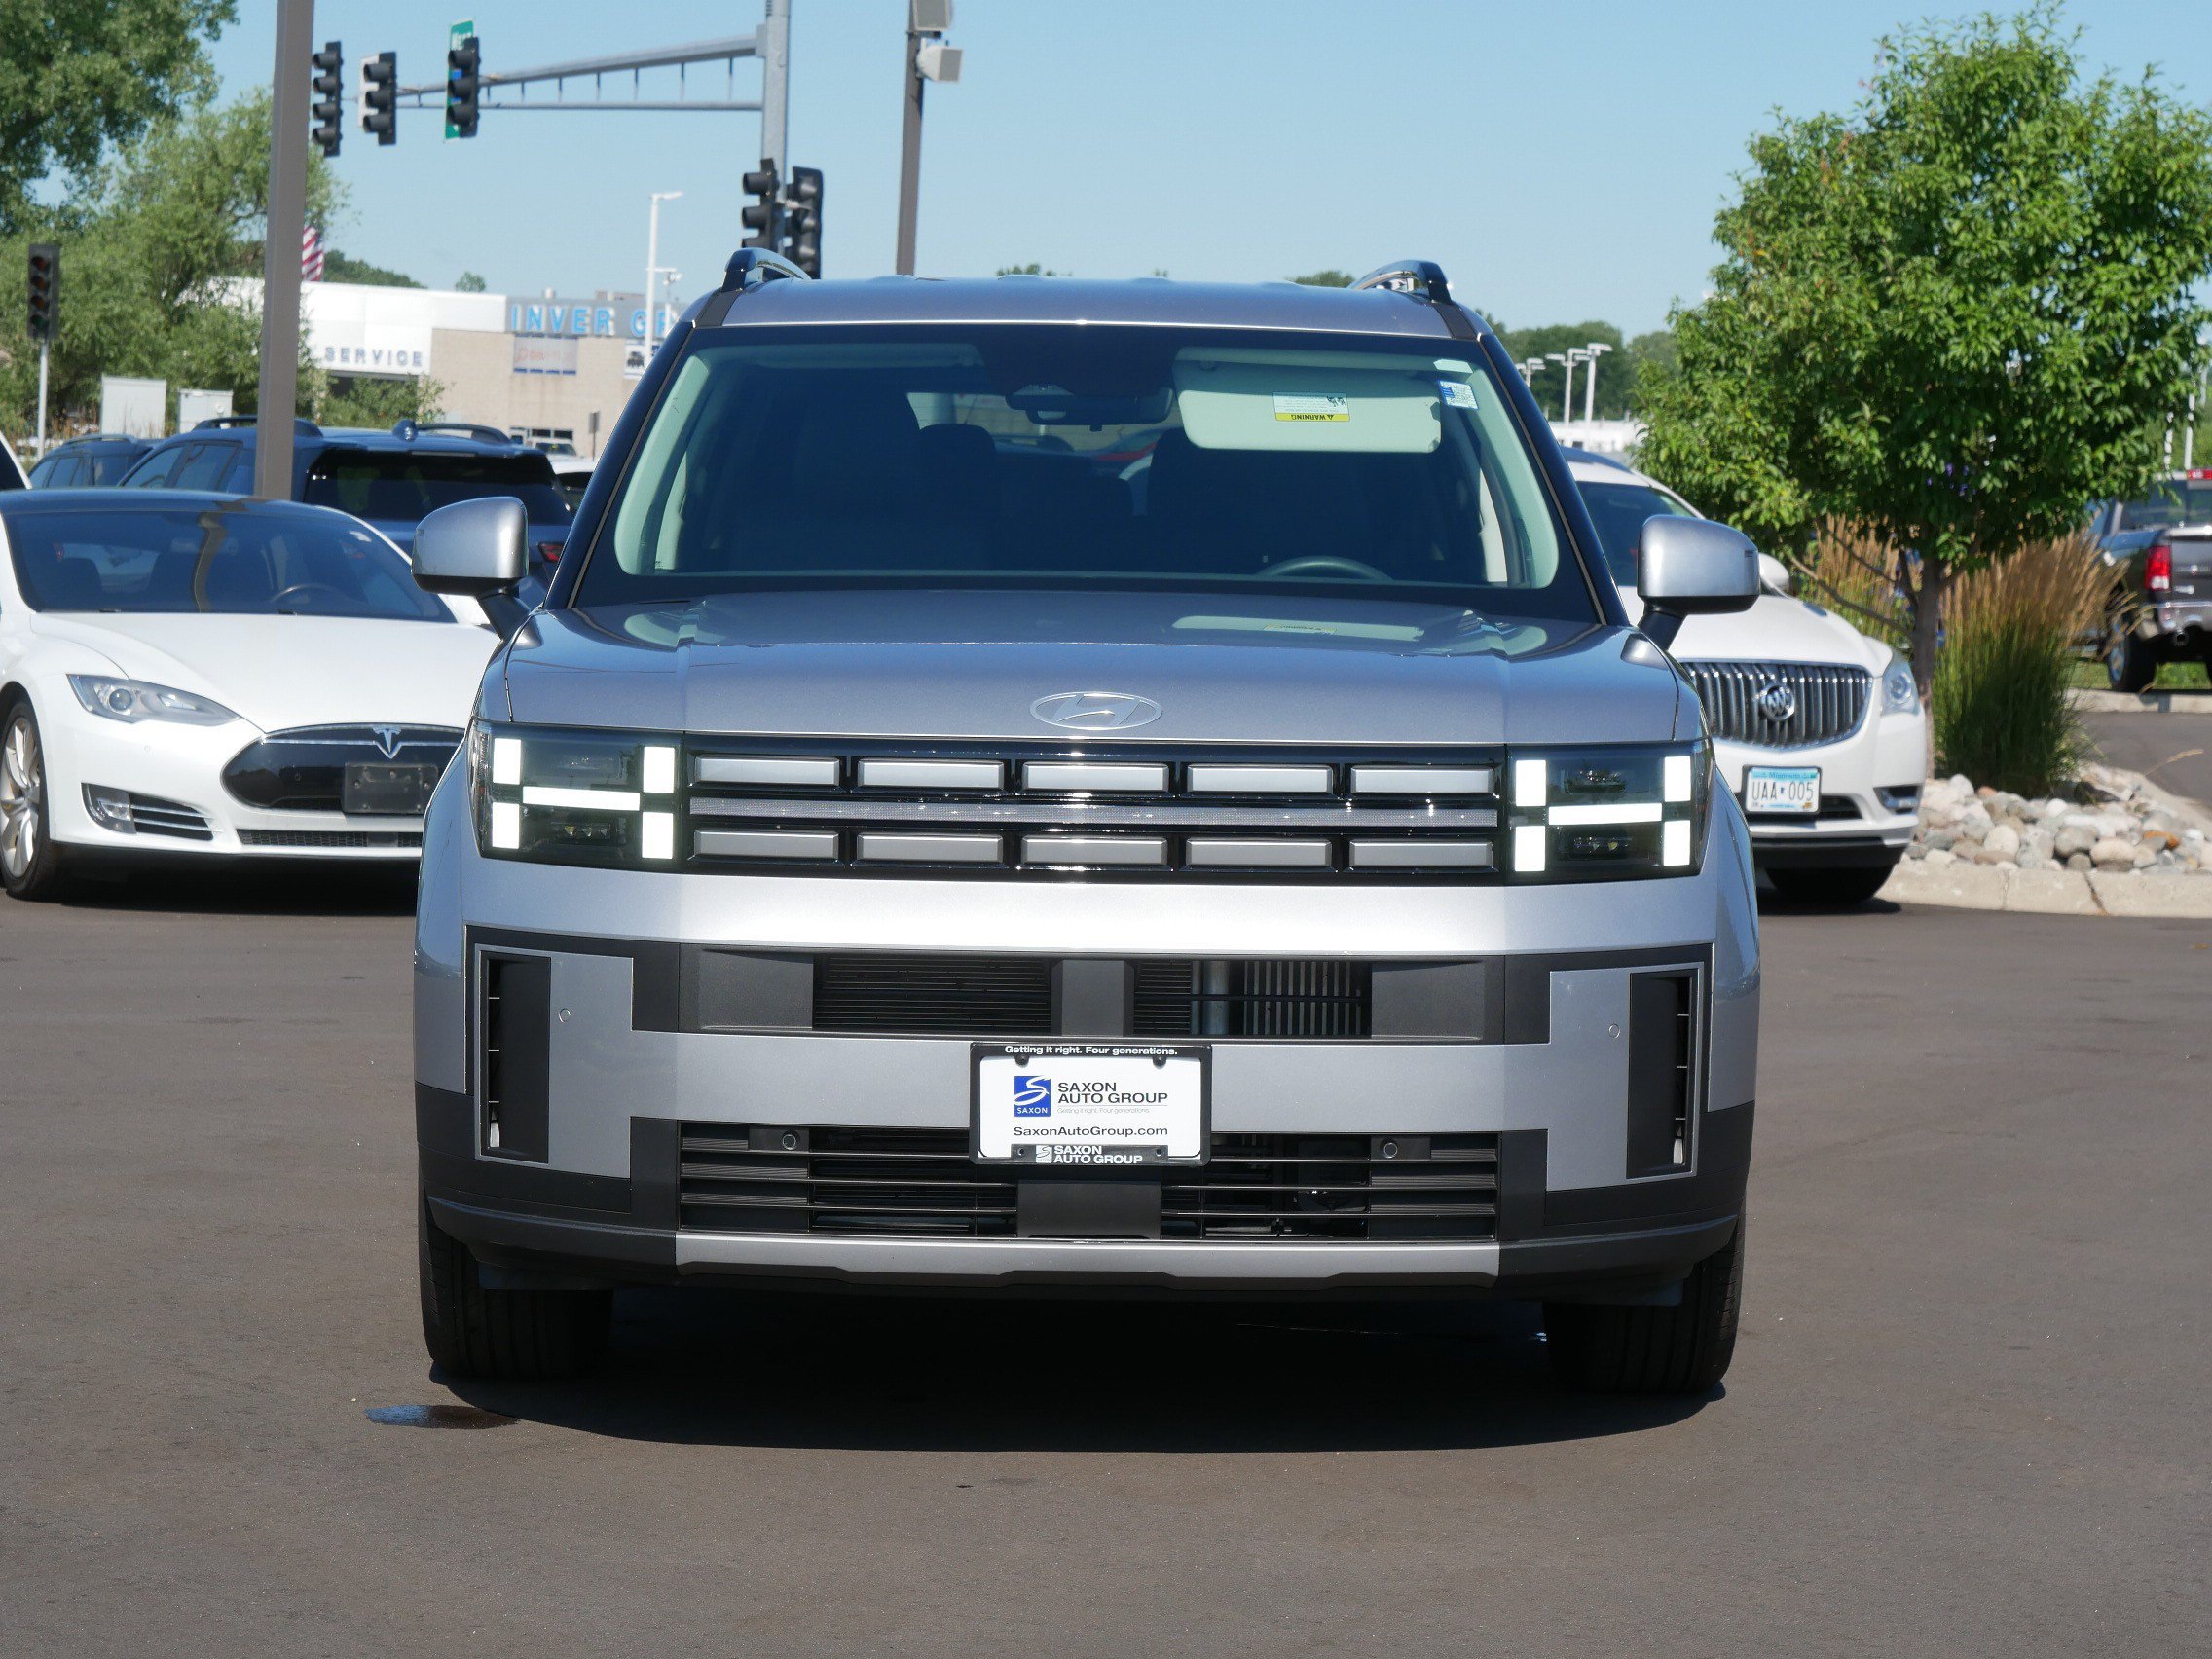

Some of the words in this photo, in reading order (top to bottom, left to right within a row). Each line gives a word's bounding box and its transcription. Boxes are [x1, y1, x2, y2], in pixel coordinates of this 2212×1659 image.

[511, 305, 614, 335] INVER
[325, 347, 422, 367] SERVICE
[1005, 1046, 1044, 1055] Getting
[1046, 1046, 1052, 1054] it
[1055, 1046, 1083, 1055] right.
[1085, 1046, 1110, 1054] Four
[1112, 1047, 1178, 1056] generations.
[1057, 1082, 1117, 1092] SAXON
[1057, 1092, 1104, 1104] AUTO
[1107, 1092, 1168, 1104] GROUP
[1014, 1126, 1168, 1138] SaxonAutoGroup.com
[1053, 1145, 1102, 1155] SAXON
[1053, 1154, 1091, 1163] AUTO
[1093, 1154, 1143, 1164] GROUP
